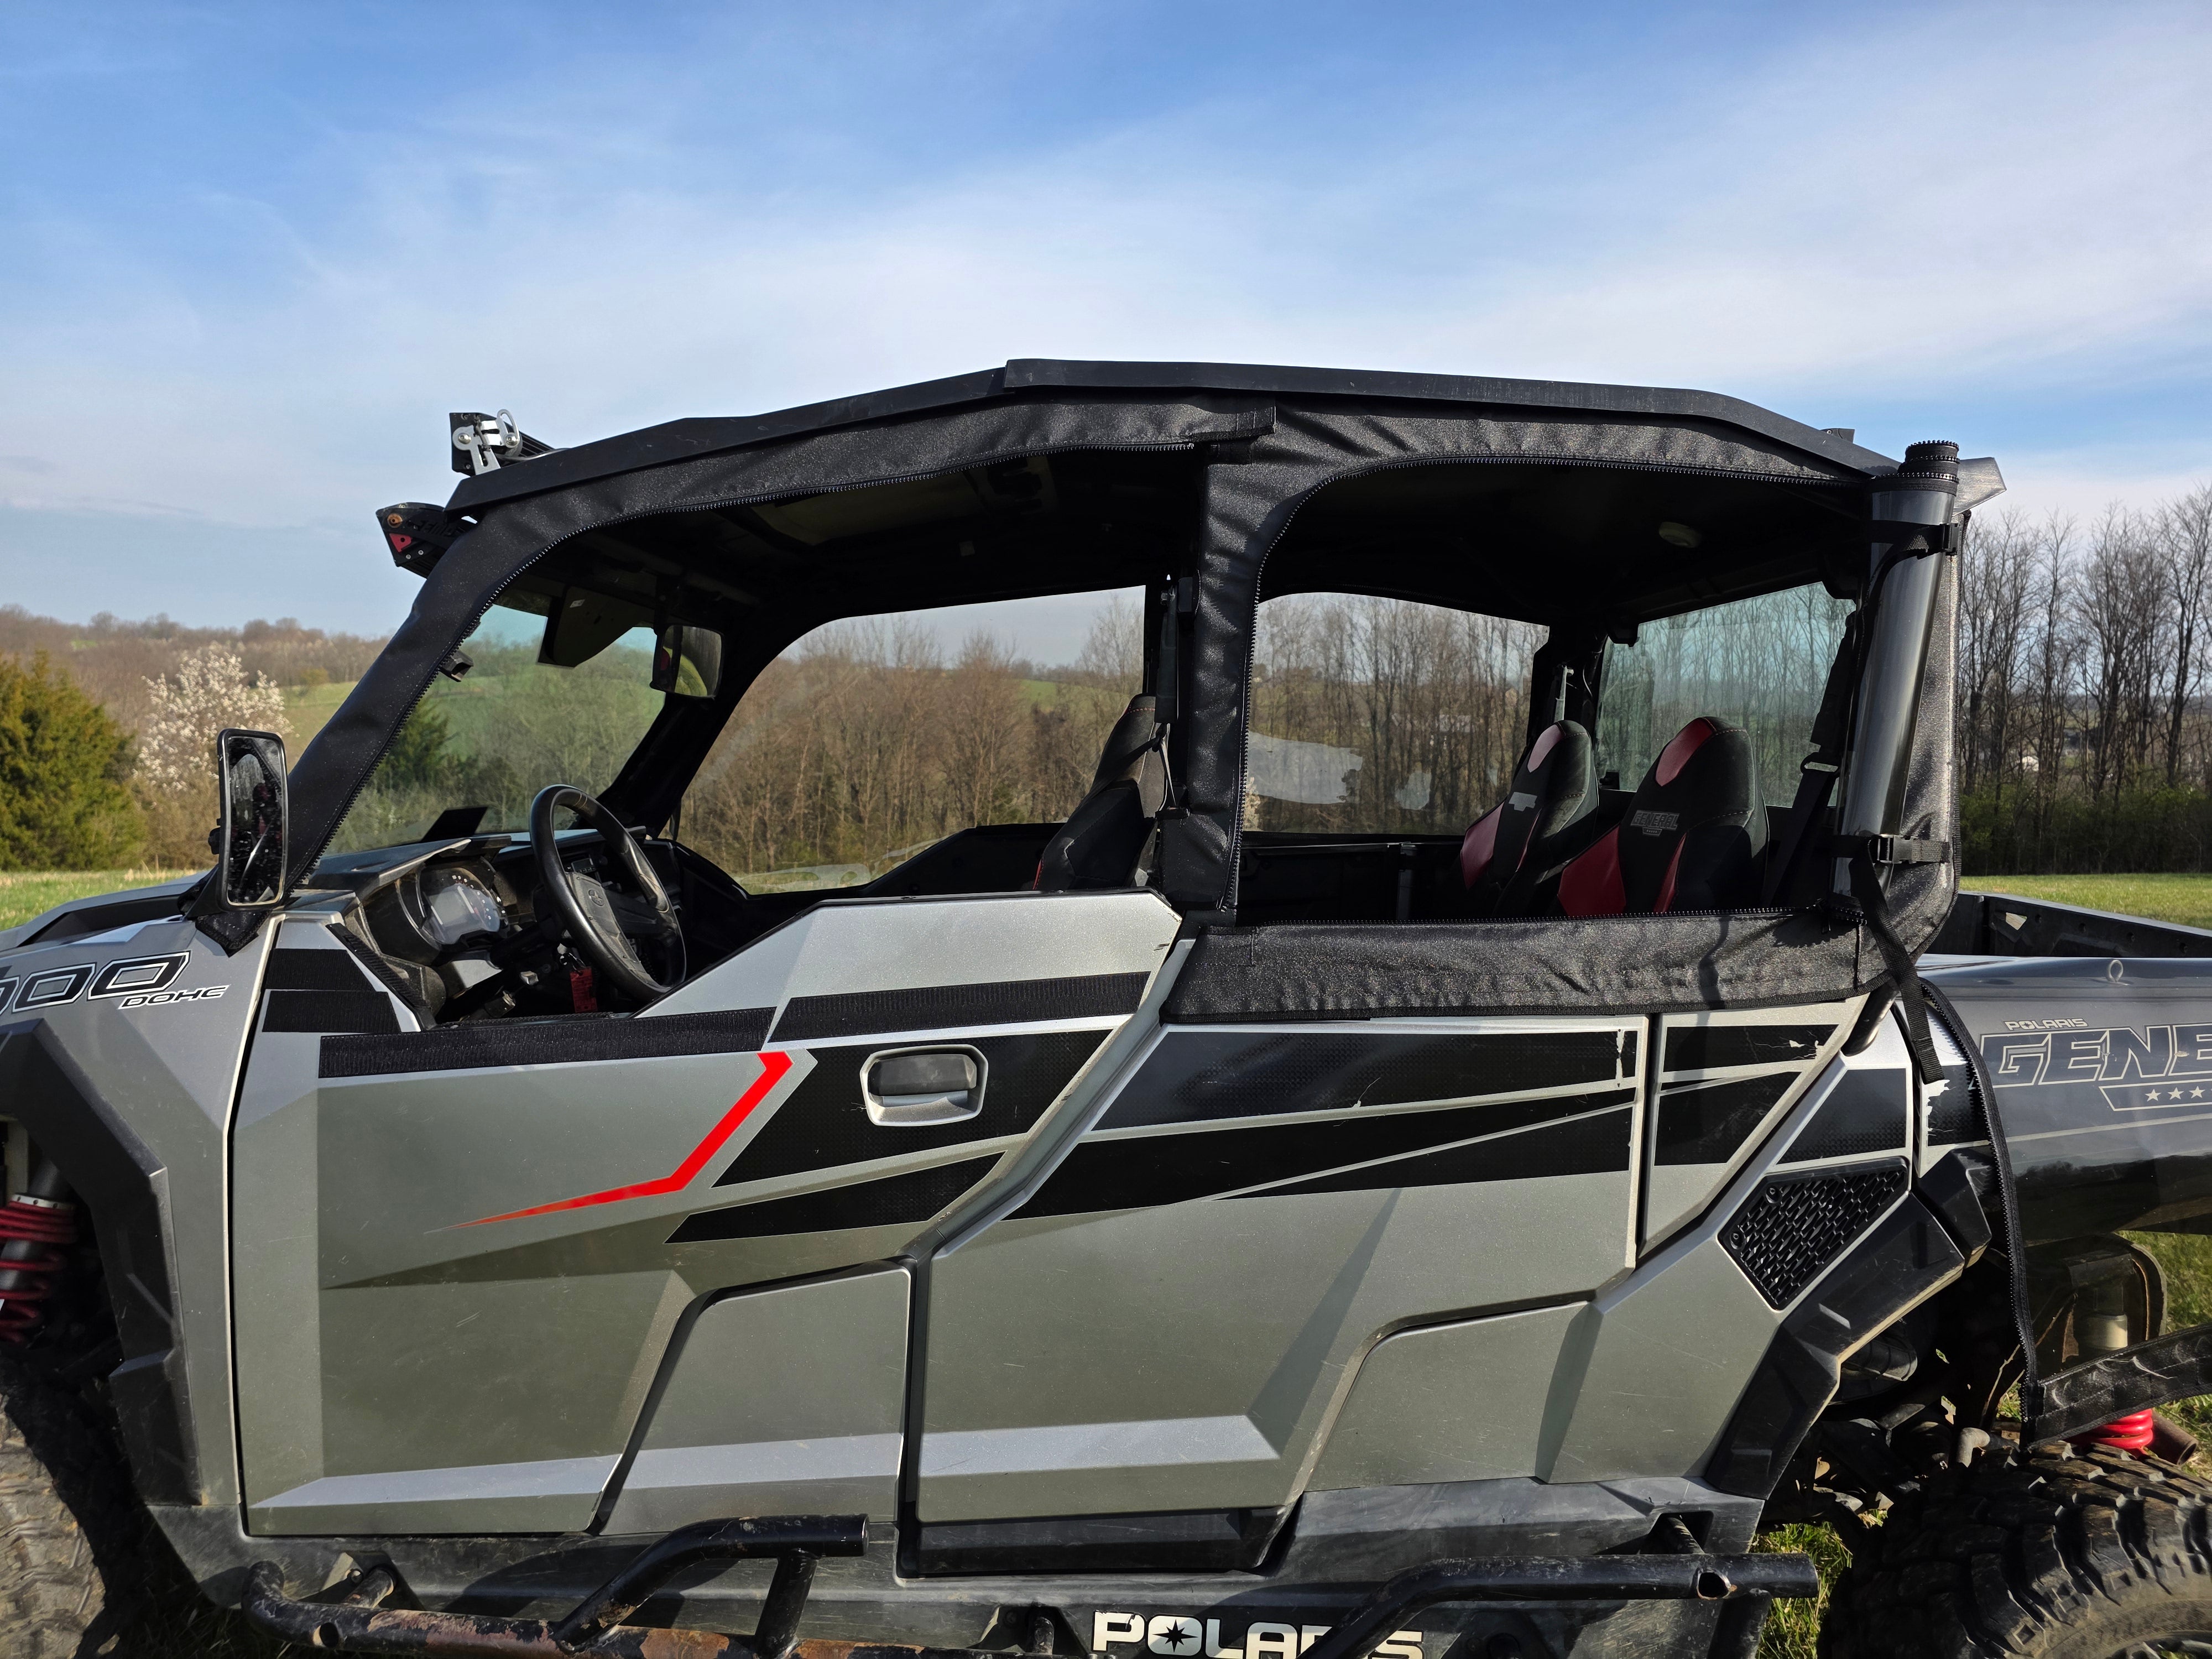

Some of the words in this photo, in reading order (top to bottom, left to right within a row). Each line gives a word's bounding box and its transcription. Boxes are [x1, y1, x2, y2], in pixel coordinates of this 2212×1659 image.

[1630, 810, 1680, 831] GENERAL
[0, 951, 191, 1016] 00
[118, 984, 232, 1010] DOHC
[2004, 1018, 2088, 1031] POLARIS
[1093, 1610, 1425, 1659] POLAS
